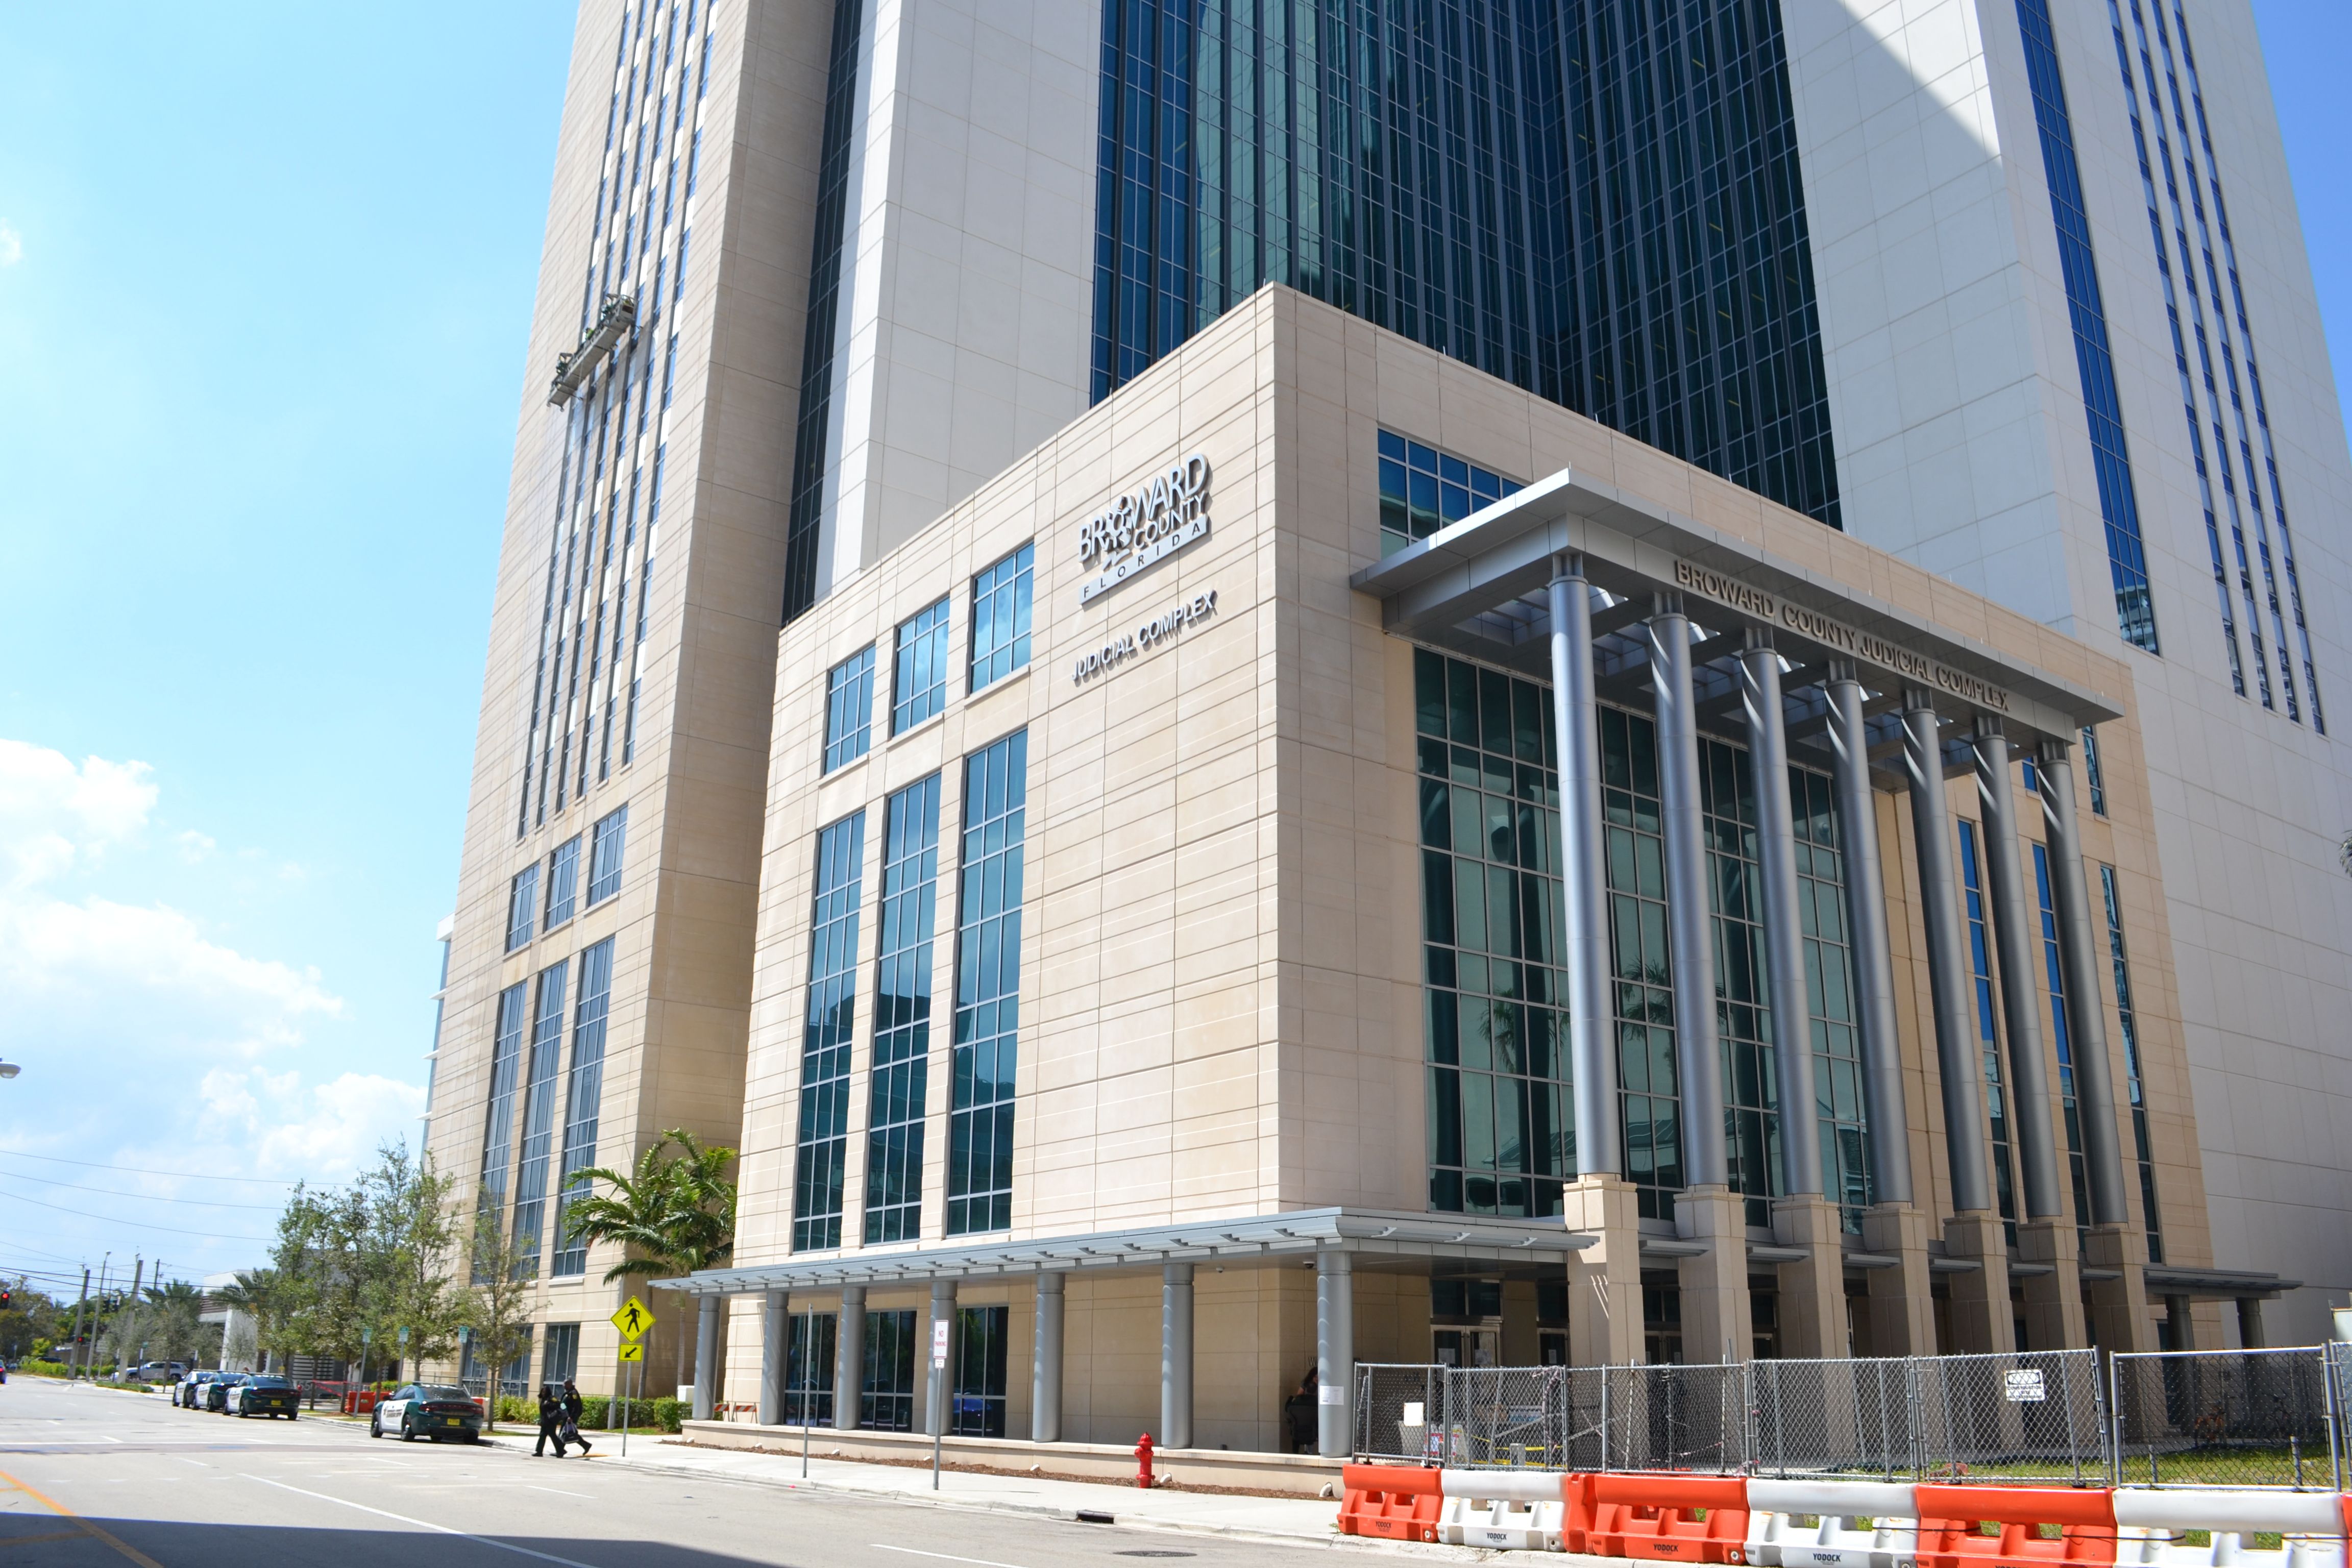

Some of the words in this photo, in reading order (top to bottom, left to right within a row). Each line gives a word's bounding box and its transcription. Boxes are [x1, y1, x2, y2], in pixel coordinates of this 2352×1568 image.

[1080, 453, 1208, 562] BROWARD
[1134, 492, 1208, 549] COUNTY
[1084, 522, 1200, 598] FLORIDA
[1071, 633, 1135, 681] JUDICIAL
[1137, 590, 1216, 645] COMPLEX
[1675, 560, 1775, 617] BROWARD
[1783, 604, 1855, 650] COUNTY
[1860, 636, 1934, 681] JUDICIAL
[1936, 666, 2010, 712] COMPLEX
[1486, 1532, 1507, 1540] YODOCK
[1653, 1544, 1678, 1552] YODOCK
[1813, 1553, 1841, 1562] YODOCK
